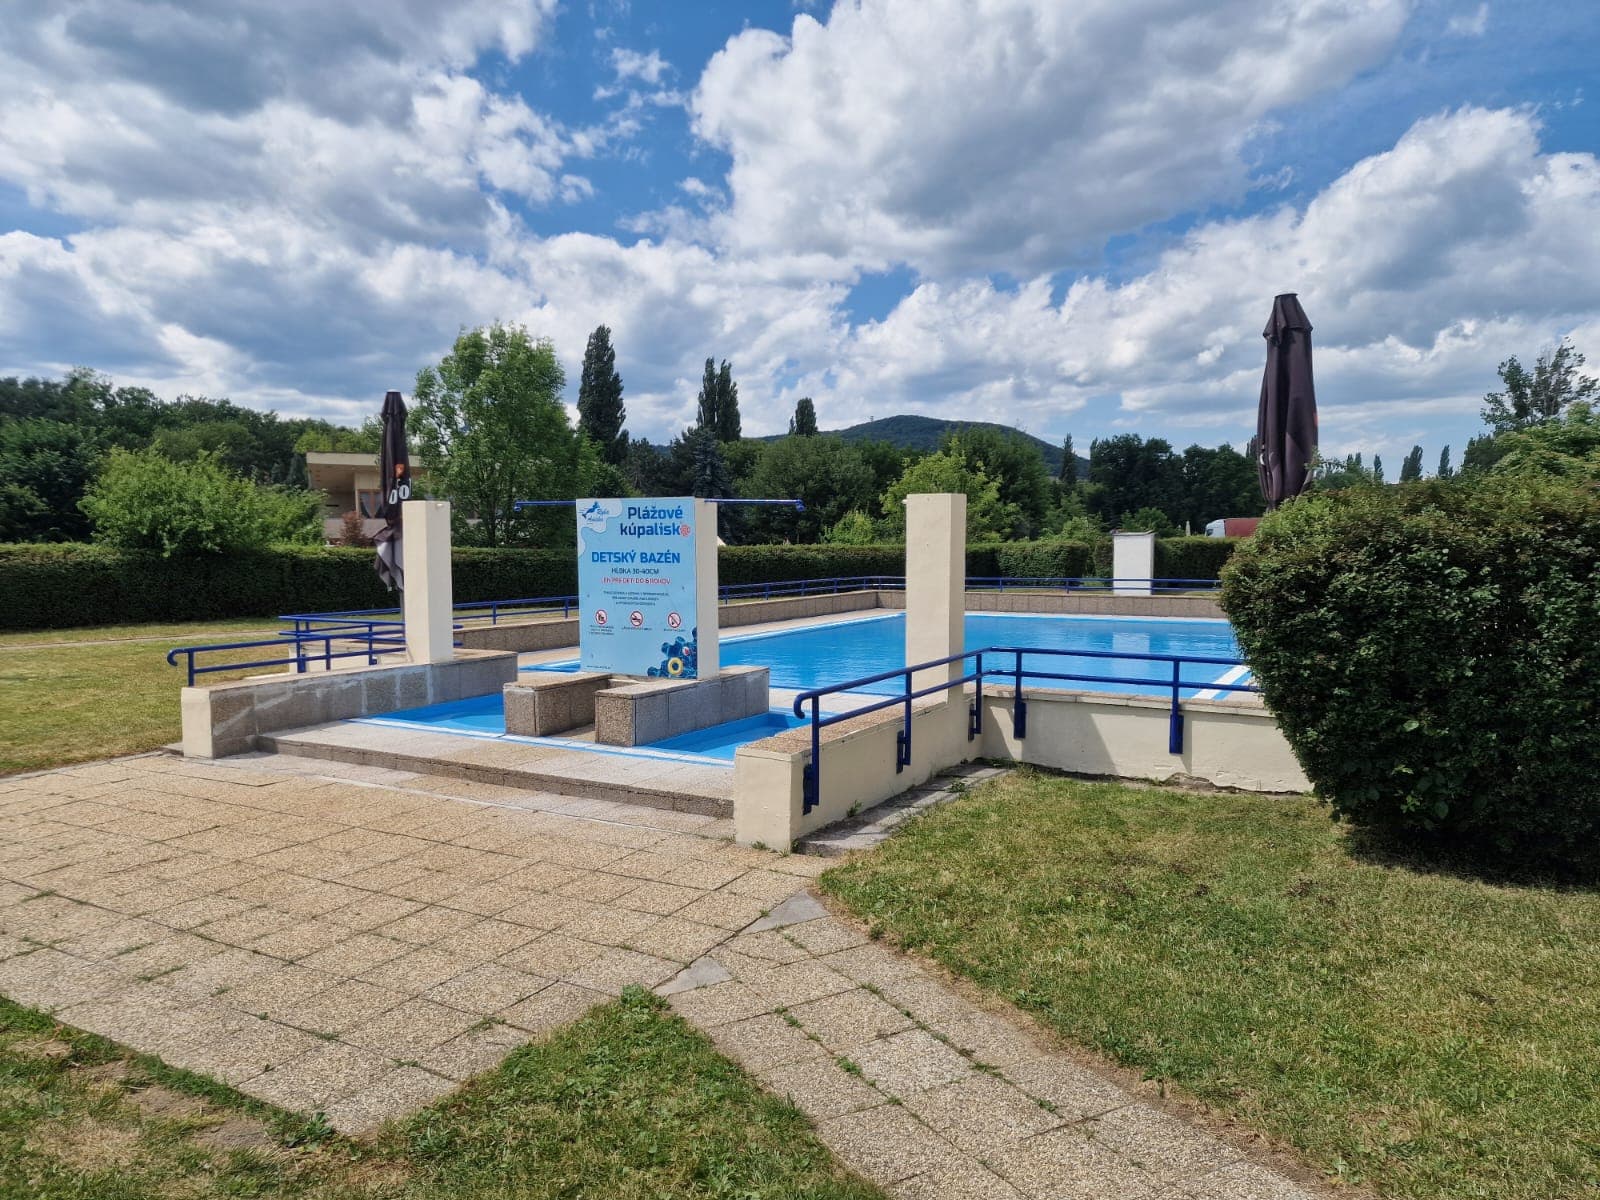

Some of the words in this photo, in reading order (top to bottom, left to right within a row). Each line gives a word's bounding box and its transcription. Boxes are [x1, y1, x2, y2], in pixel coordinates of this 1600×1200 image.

[627, 505, 684, 519] Plážové
[591, 549, 637, 563] DETSKÝ
[640, 549, 681, 564] BAZÉN
